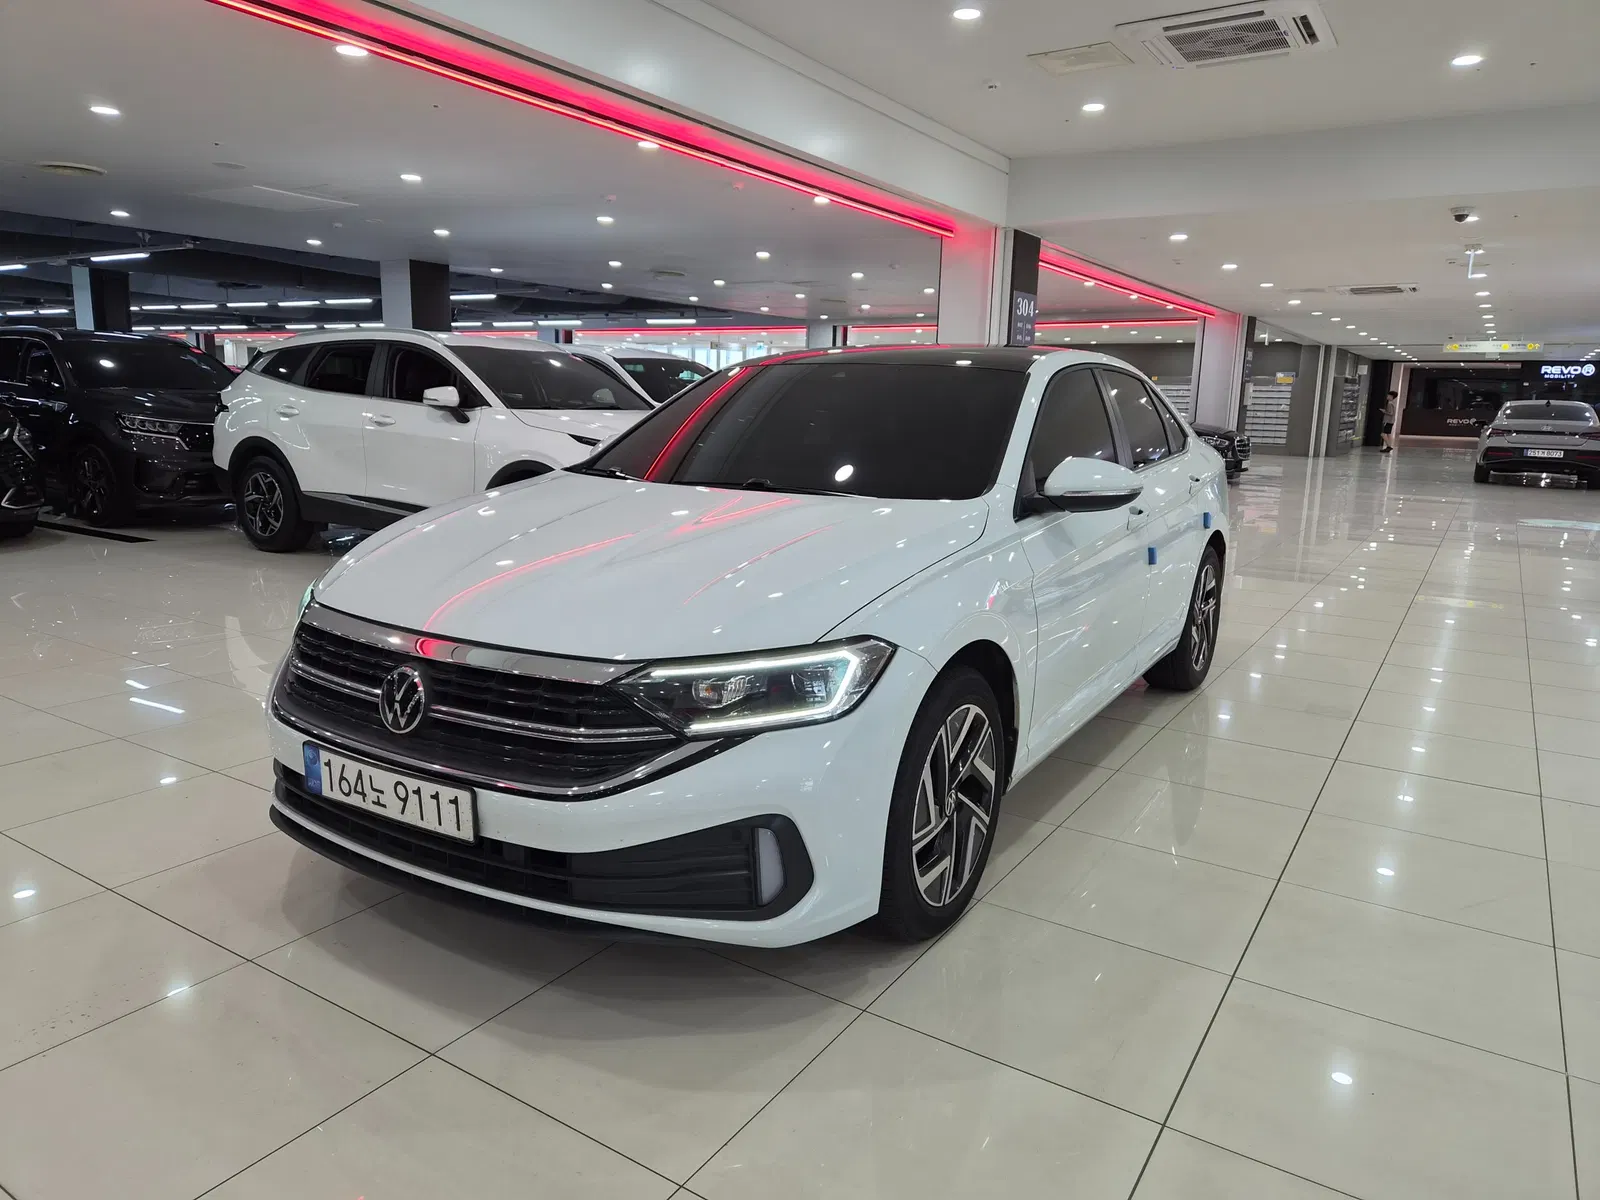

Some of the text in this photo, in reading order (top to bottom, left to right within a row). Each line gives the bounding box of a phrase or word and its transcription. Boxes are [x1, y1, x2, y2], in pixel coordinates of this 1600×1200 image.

[1016, 297, 1034, 317] 304
[1541, 365, 1582, 375] REVO
[323, 758, 461, 832] 164노 9111
